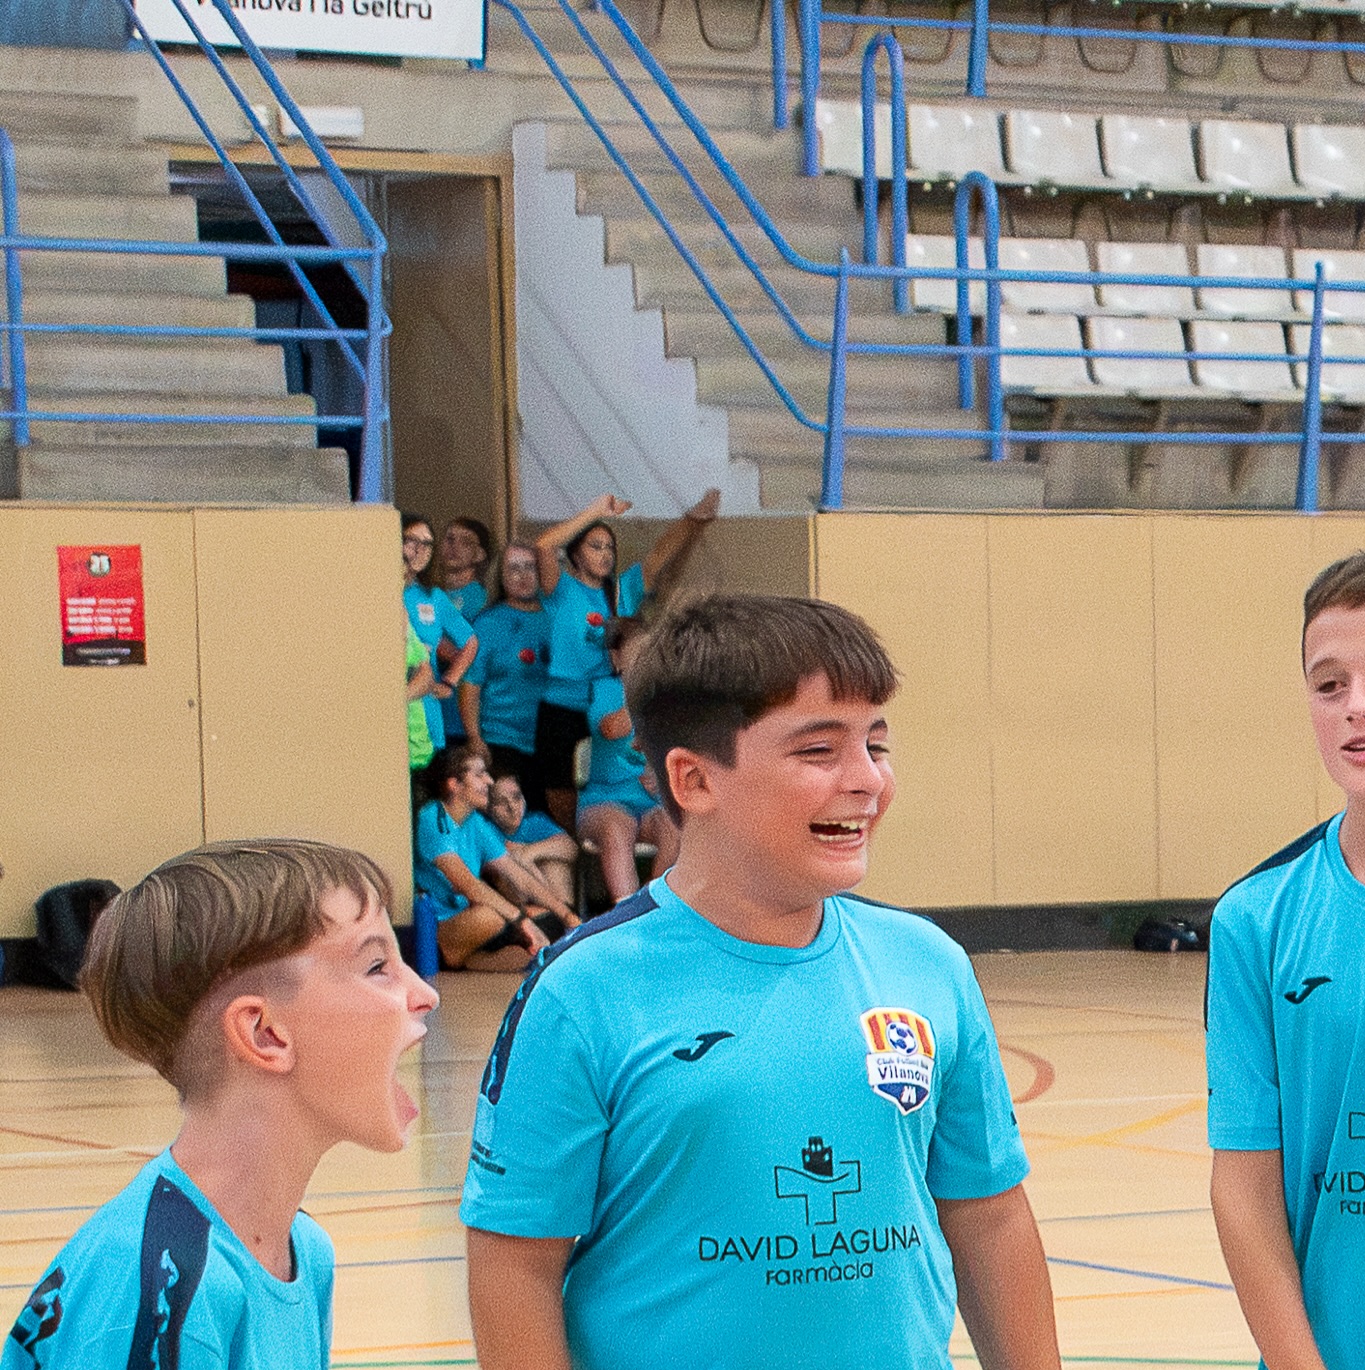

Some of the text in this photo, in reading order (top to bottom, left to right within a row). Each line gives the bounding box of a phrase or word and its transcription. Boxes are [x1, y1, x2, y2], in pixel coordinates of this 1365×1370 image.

[877, 1064, 930, 1085] Vilanova
[698, 1224, 922, 1262] DAVID LAGUNA
